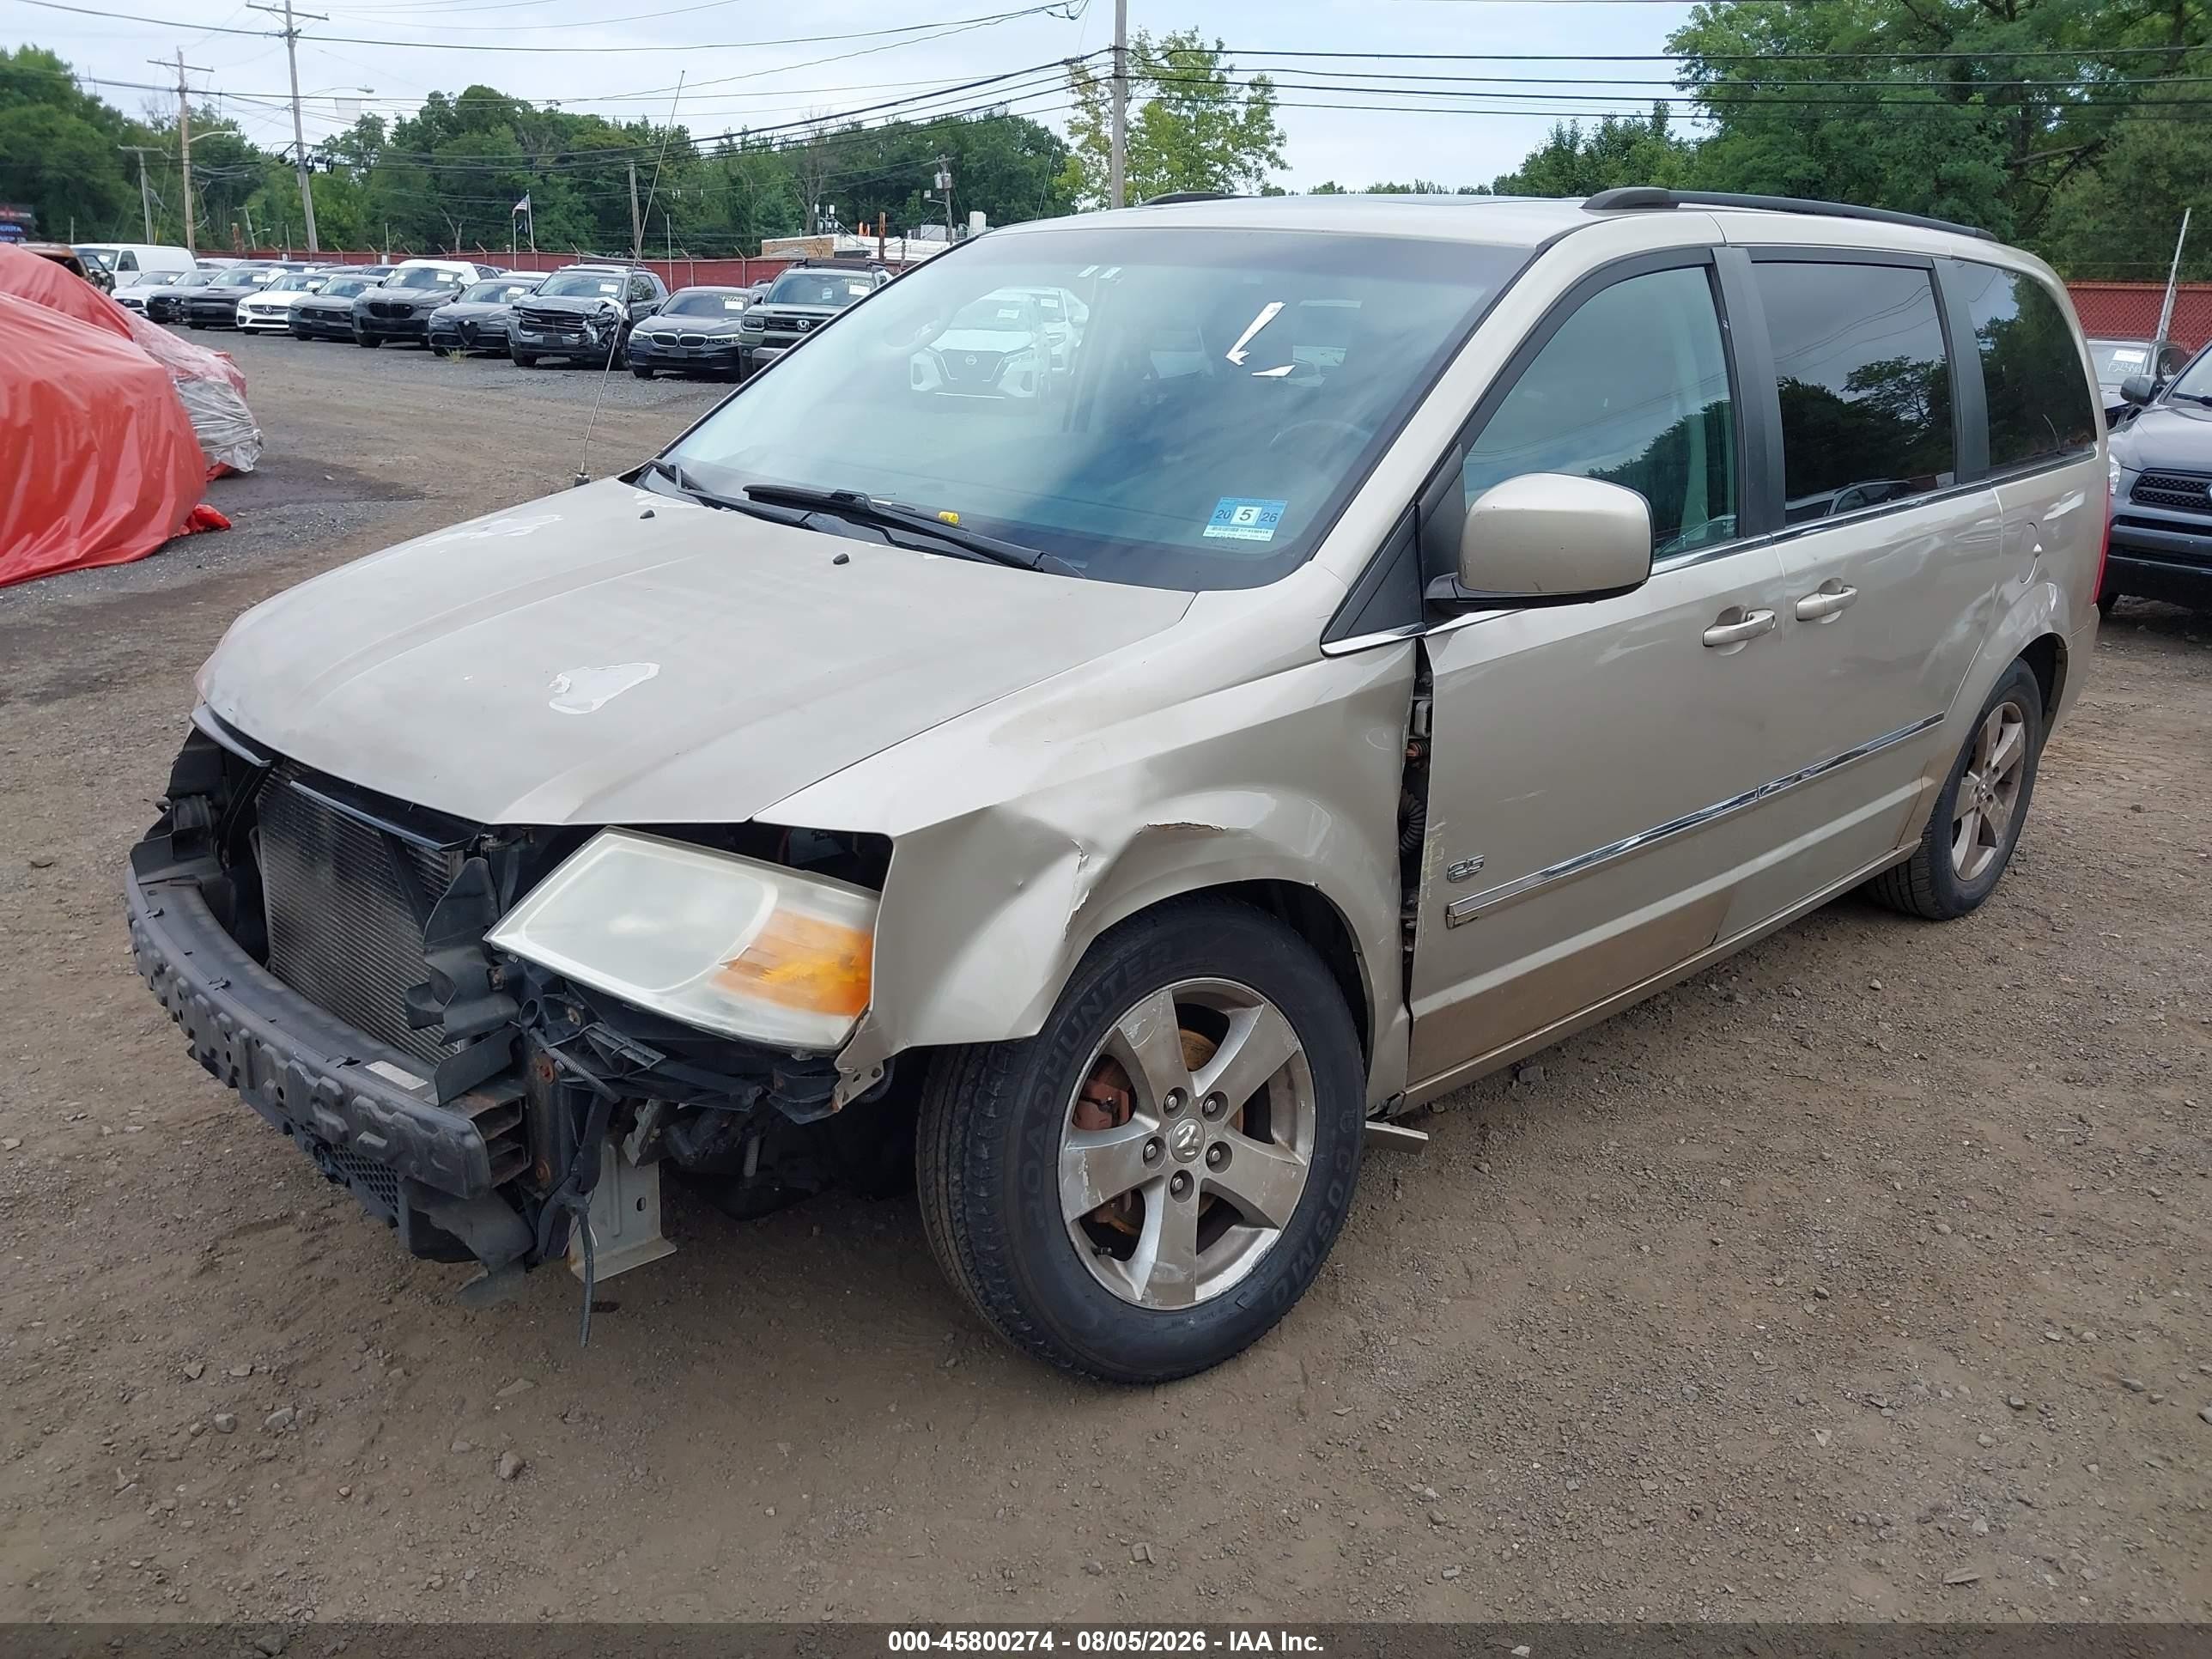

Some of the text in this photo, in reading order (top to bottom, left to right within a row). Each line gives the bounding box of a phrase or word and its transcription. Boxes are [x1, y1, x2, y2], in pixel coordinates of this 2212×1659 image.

[1216, 509, 1278, 523] 20 5 26
